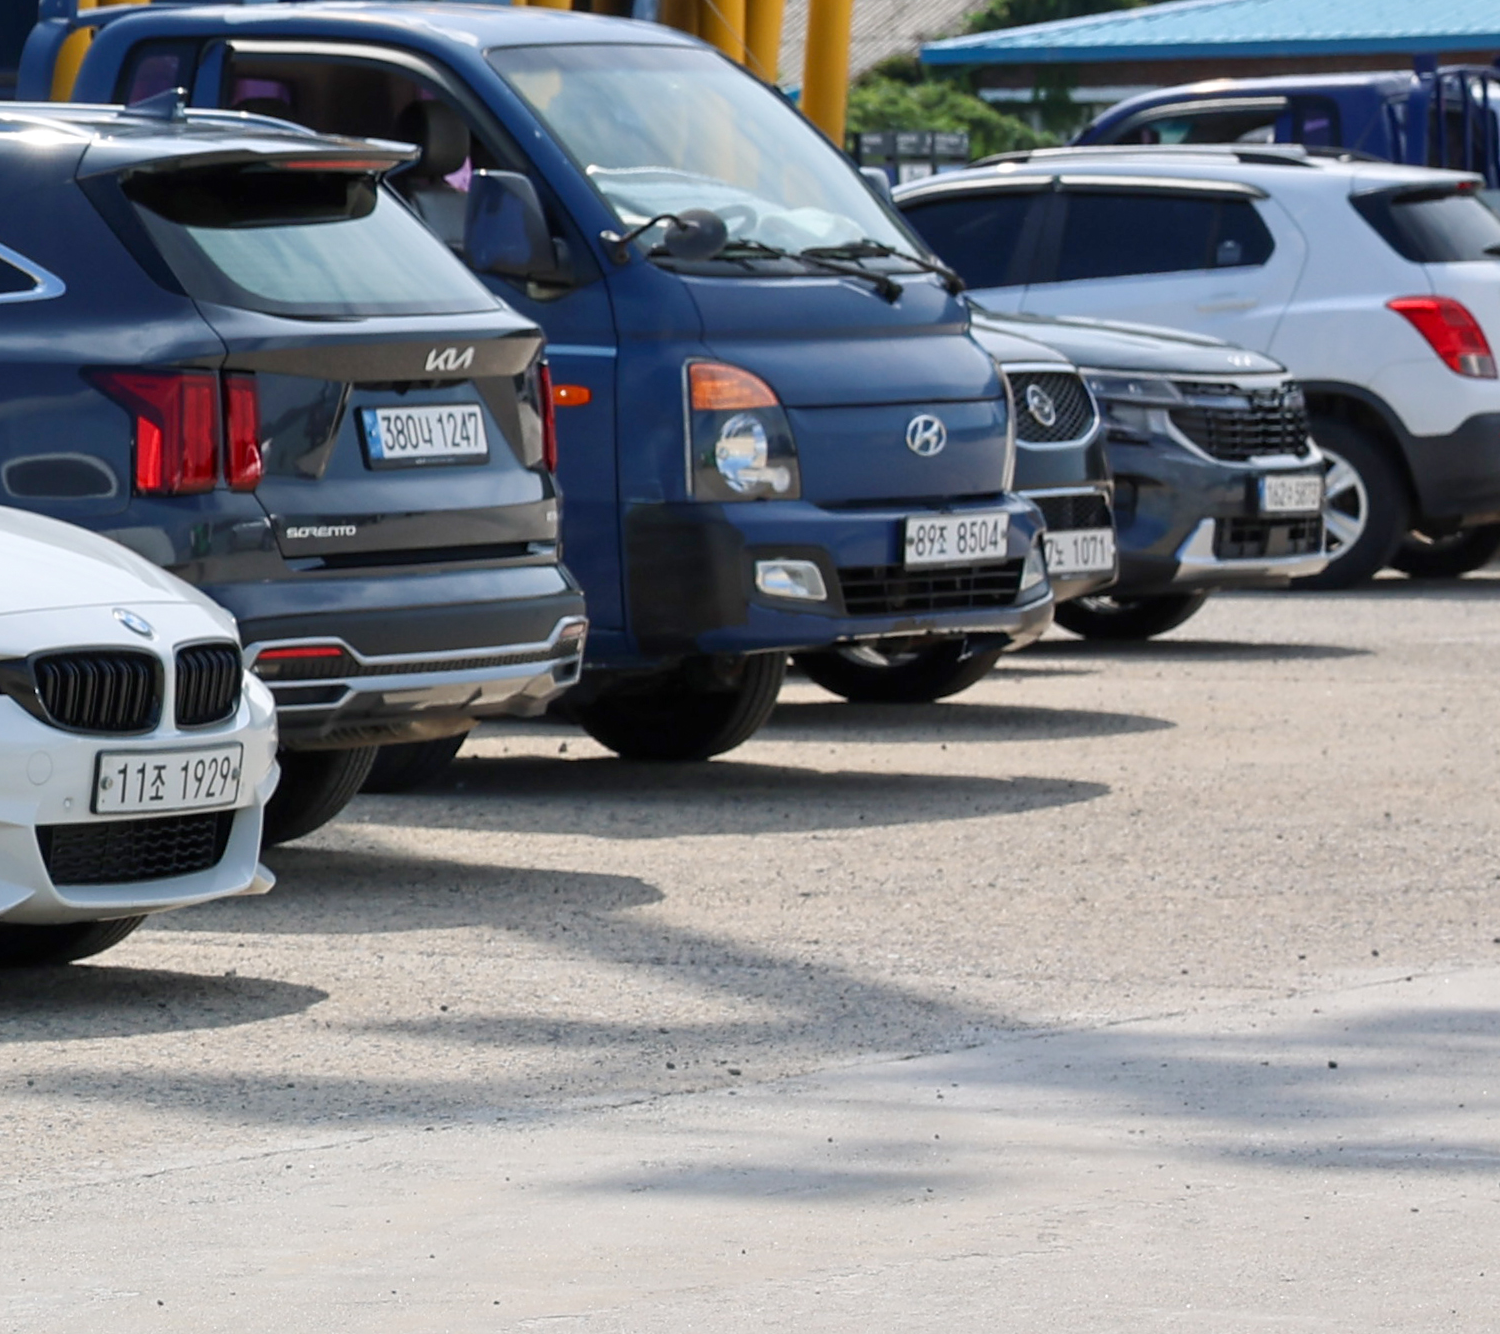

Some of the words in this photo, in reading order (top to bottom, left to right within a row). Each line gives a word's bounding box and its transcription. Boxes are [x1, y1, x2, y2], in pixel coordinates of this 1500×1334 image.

[381, 414, 433, 451] 380나
[438, 412, 480, 447] 1247
[286, 525, 357, 539] SORENTO
[915, 524, 947, 556] 89조
[957, 521, 999, 554] 8504
[1045, 539, 1064, 565] 7노
[1072, 537, 1106, 566] 1071
[117, 762, 167, 804] 11조
[180, 756, 231, 800] 1929
